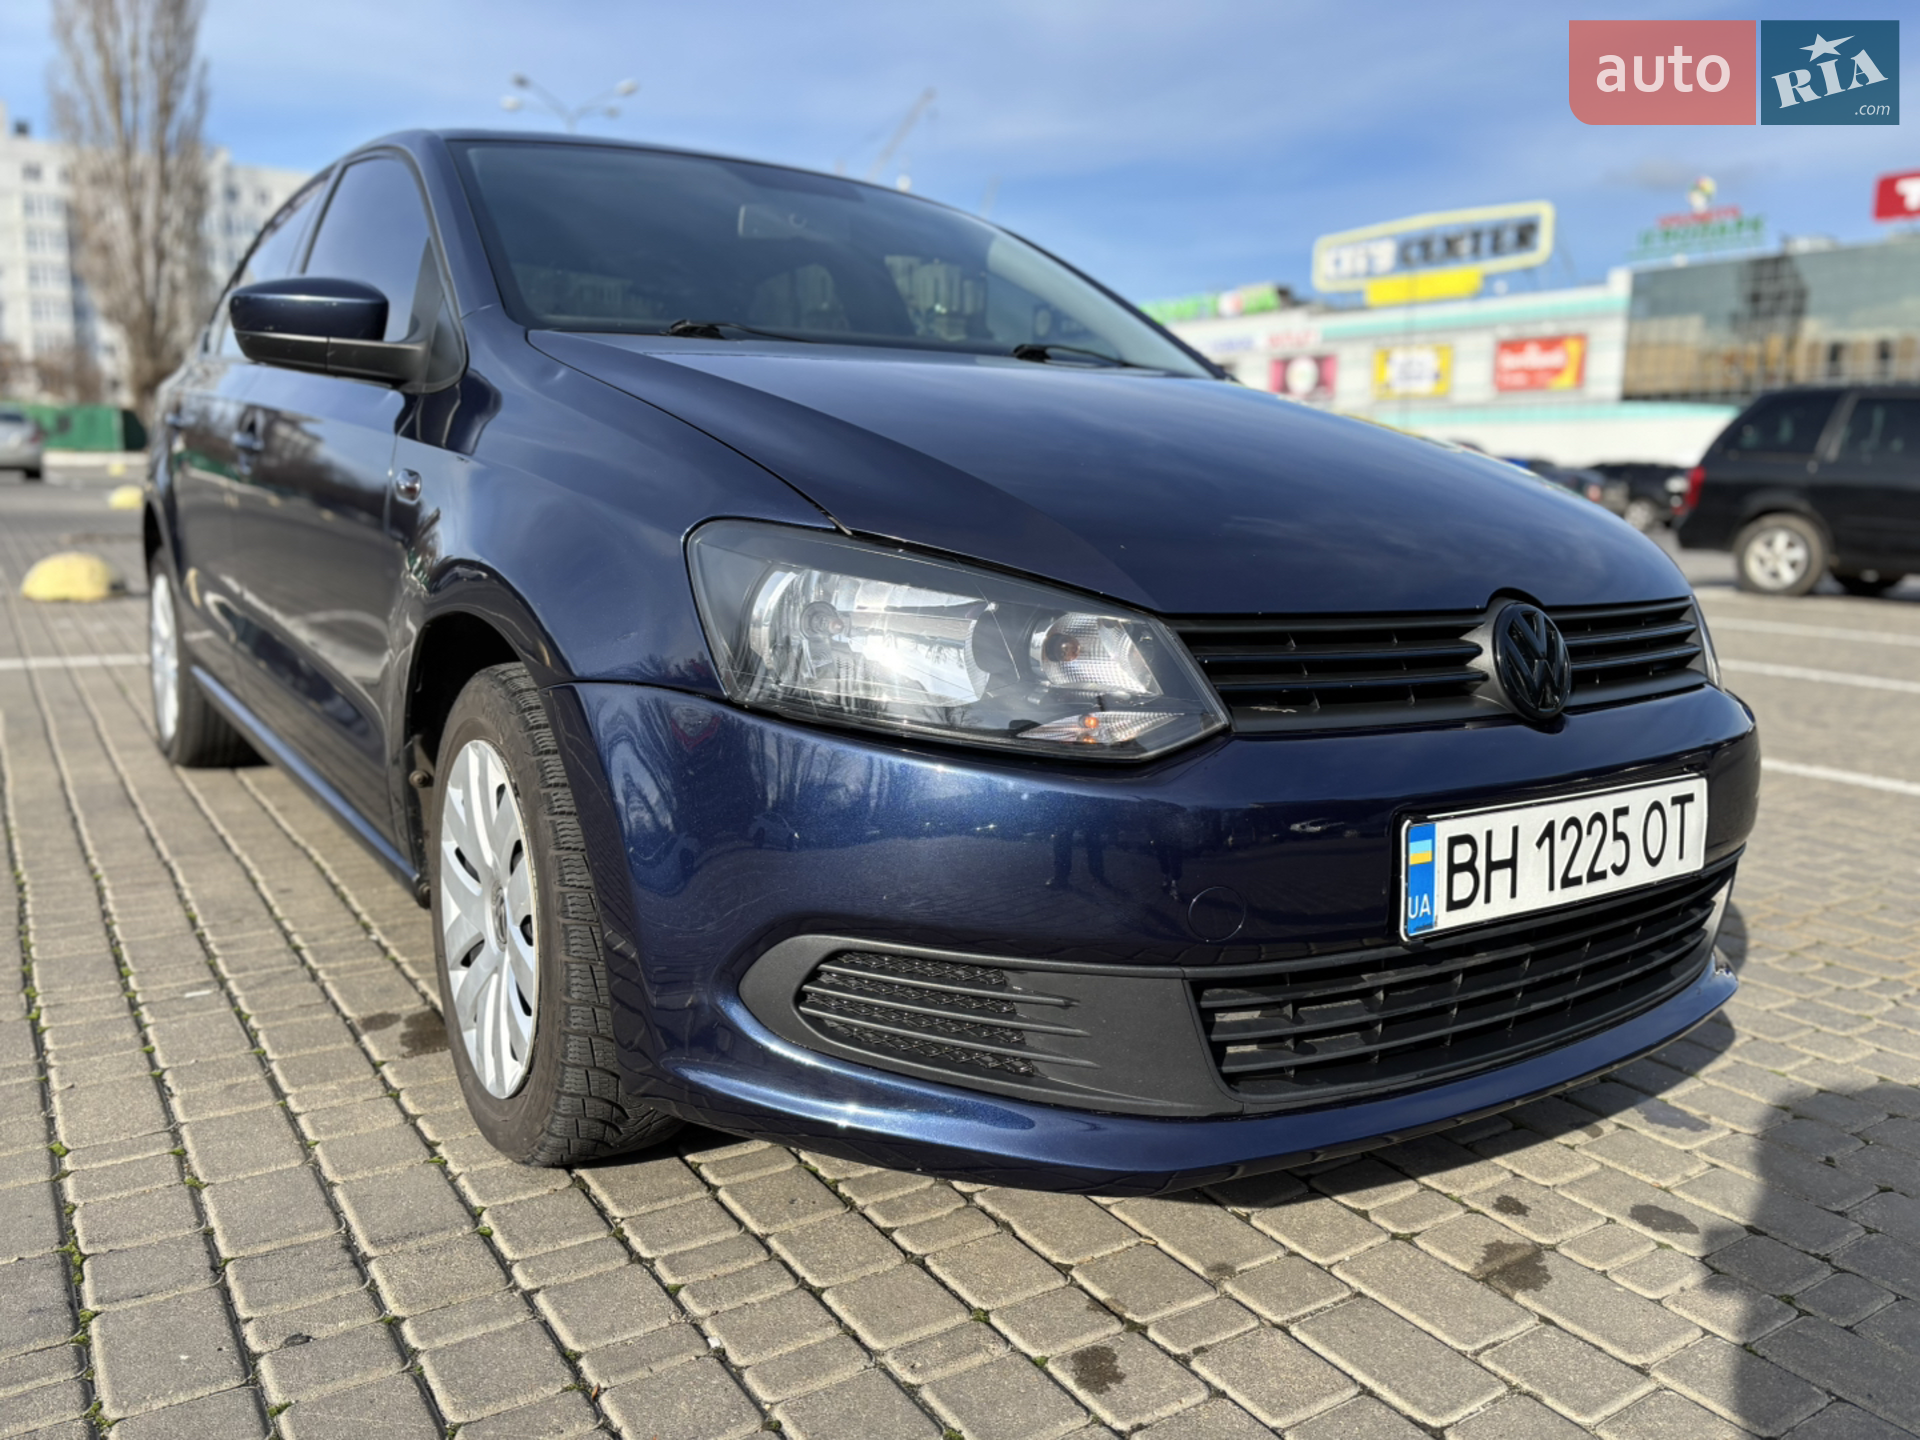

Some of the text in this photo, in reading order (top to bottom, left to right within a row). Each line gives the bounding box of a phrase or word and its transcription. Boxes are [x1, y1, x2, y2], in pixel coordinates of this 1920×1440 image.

[1446, 792, 1695, 912] BH 1225 OT
[1408, 893, 1432, 919] UA
